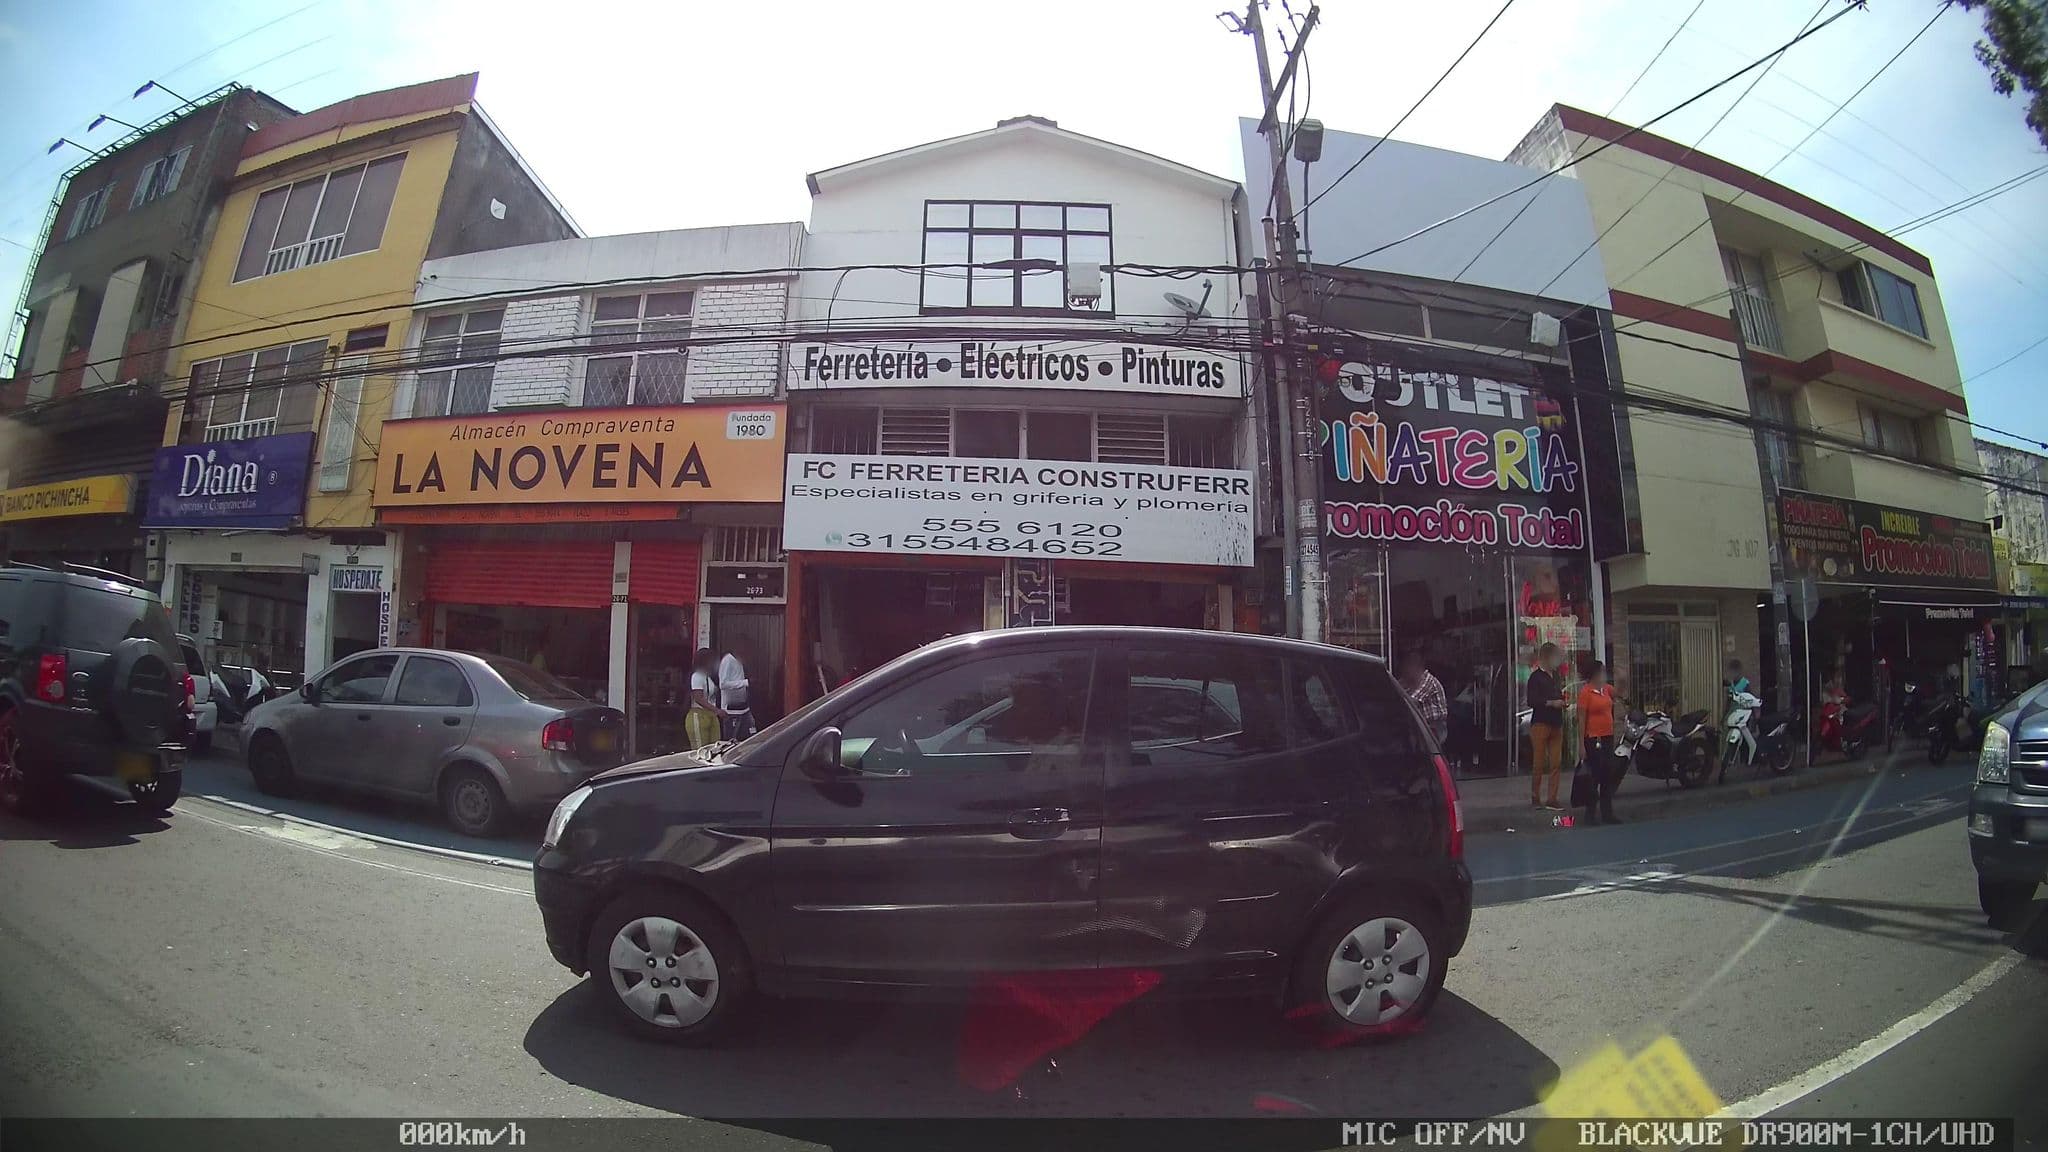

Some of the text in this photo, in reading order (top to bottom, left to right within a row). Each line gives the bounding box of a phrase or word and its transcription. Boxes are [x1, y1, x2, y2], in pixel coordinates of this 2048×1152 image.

[804, 343, 1225, 389] Ferretería Eléctricos Pinturas
[1338, 361, 1530, 419] OUTLET
[450, 416, 675, 440] Almacén Compraventa
[731, 413, 771, 436] Fundada 1980
[177, 449, 259, 497] Diana
[392, 441, 712, 493] LA NOVENA
[803, 461, 1250, 496] FC FERRETERIA CONSTRUFERR
[6, 486, 90, 513] BANCO PICHINCHA
[791, 484, 961, 501] Especialistas
[971, 491, 1002, 502] en
[1113, 498, 1128, 510] y
[1137, 497, 1248, 513] plomería
[922, 518, 1122, 538] 555 6120
[1499, 503, 1583, 549] Total
[848, 533, 1122, 556] 3155484652
[333, 569, 383, 589] HOSPEDATE
